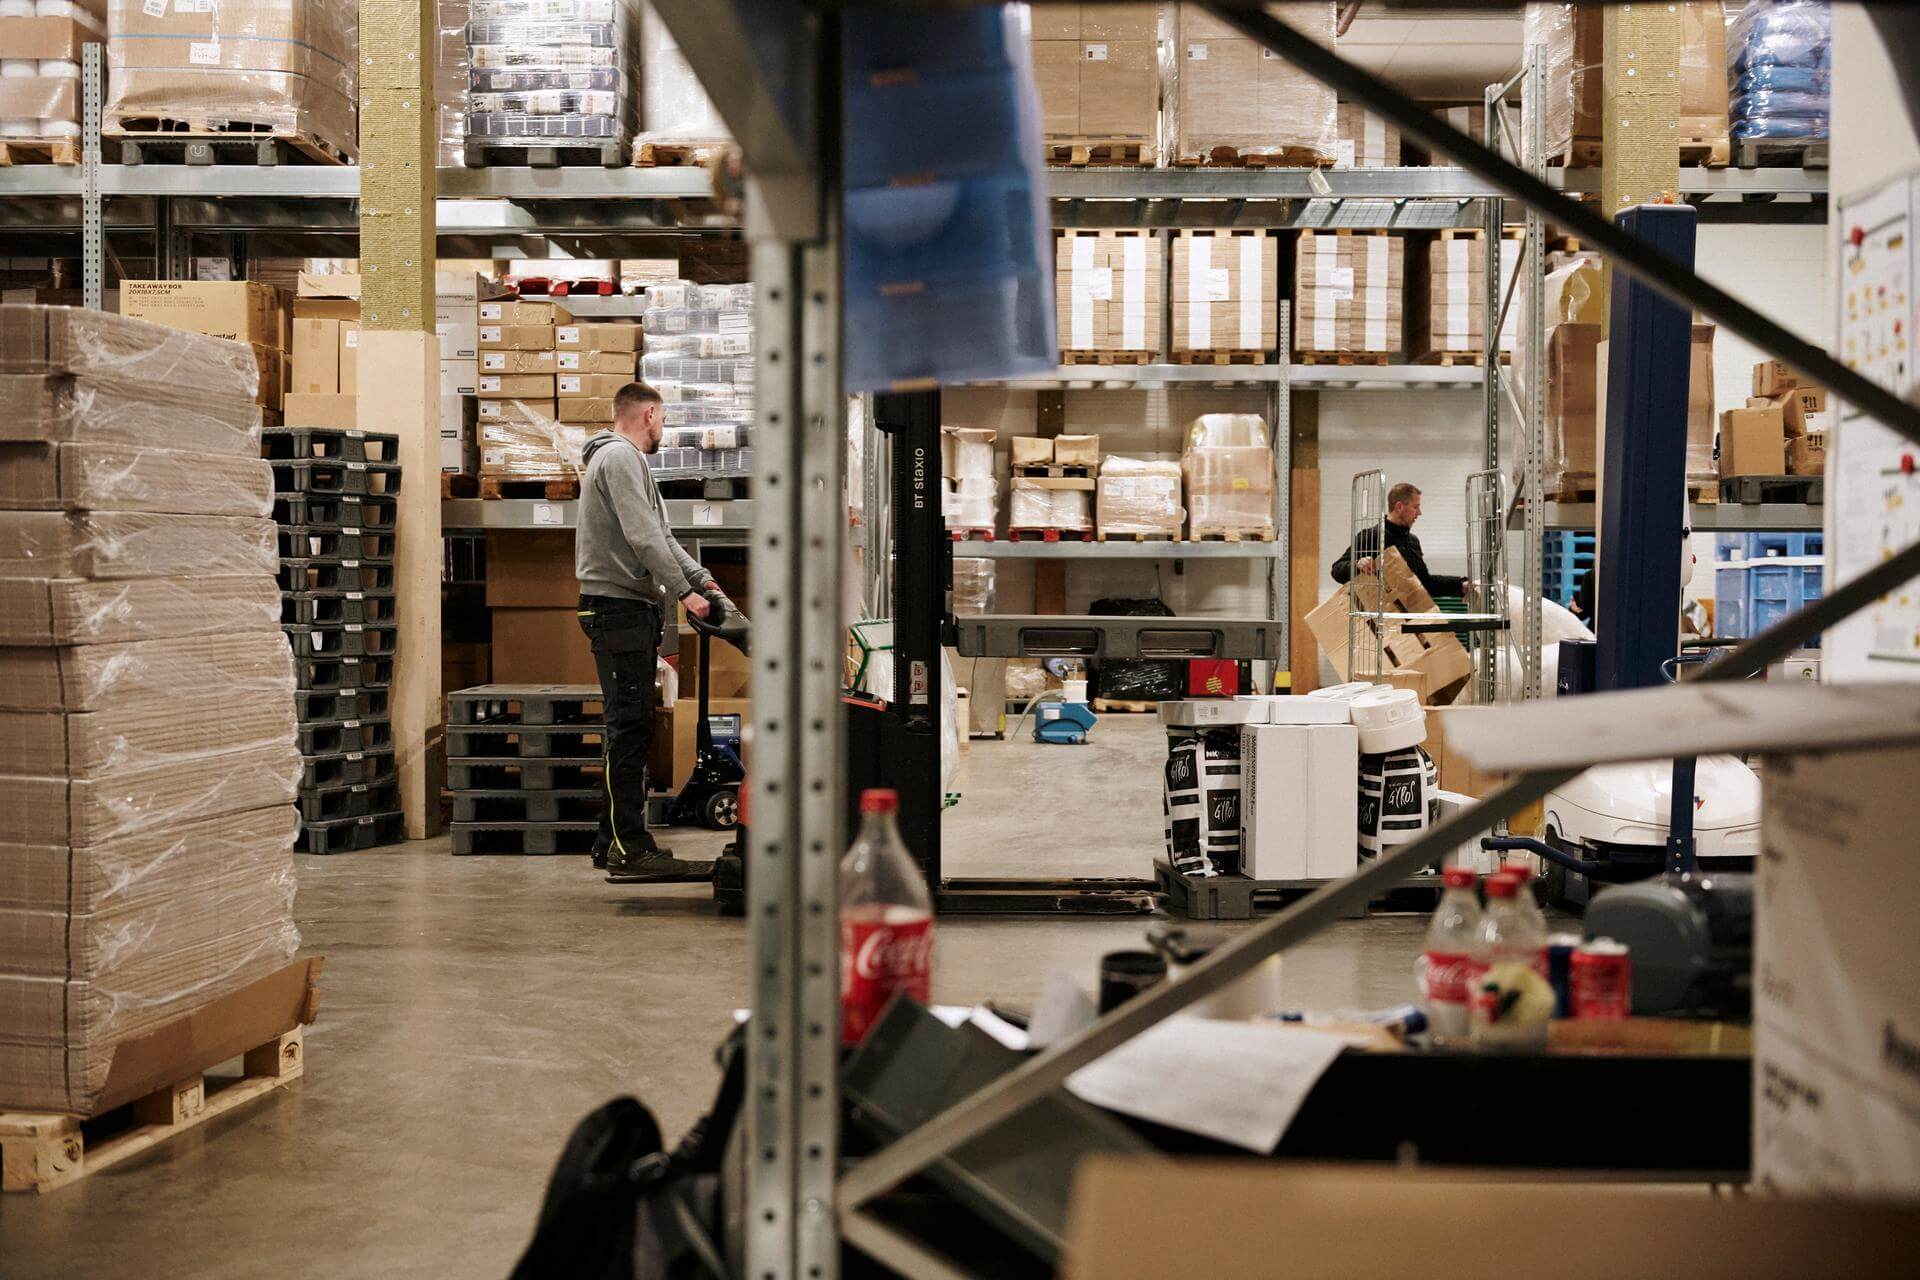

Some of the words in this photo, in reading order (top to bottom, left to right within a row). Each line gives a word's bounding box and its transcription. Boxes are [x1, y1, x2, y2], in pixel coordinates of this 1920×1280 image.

[914, 493, 924, 508] BT
[1388, 781, 1416, 808] GYROS
[1214, 796, 1237, 823] GYROS
